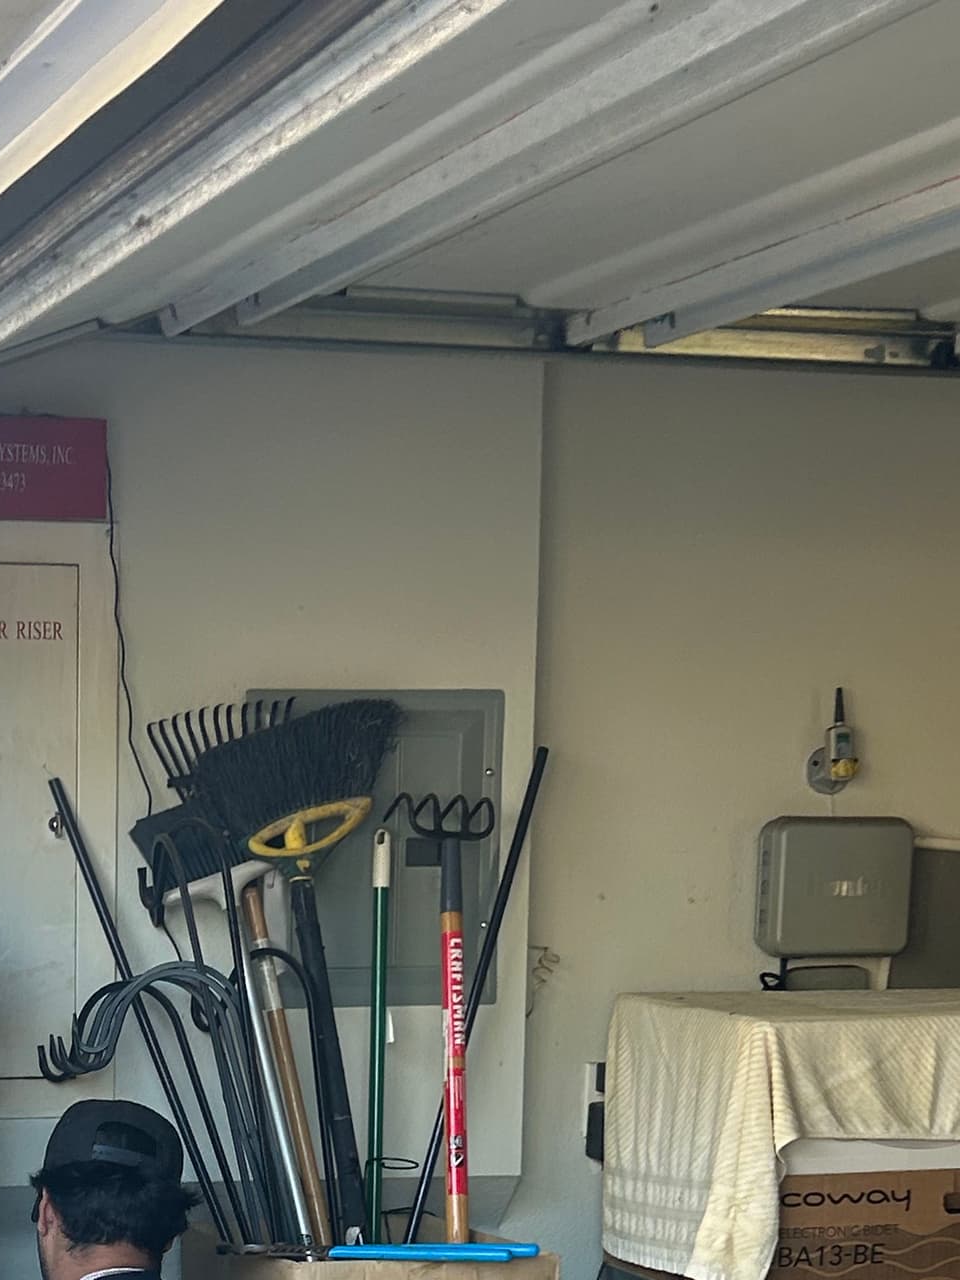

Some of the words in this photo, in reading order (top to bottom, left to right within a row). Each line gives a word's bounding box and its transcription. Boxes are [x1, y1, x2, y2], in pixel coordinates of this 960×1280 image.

[15, 621, 64, 641] RISER
[780, 1188, 912, 1212] coway
[778, 1243, 886, 1268] BA13-BE
